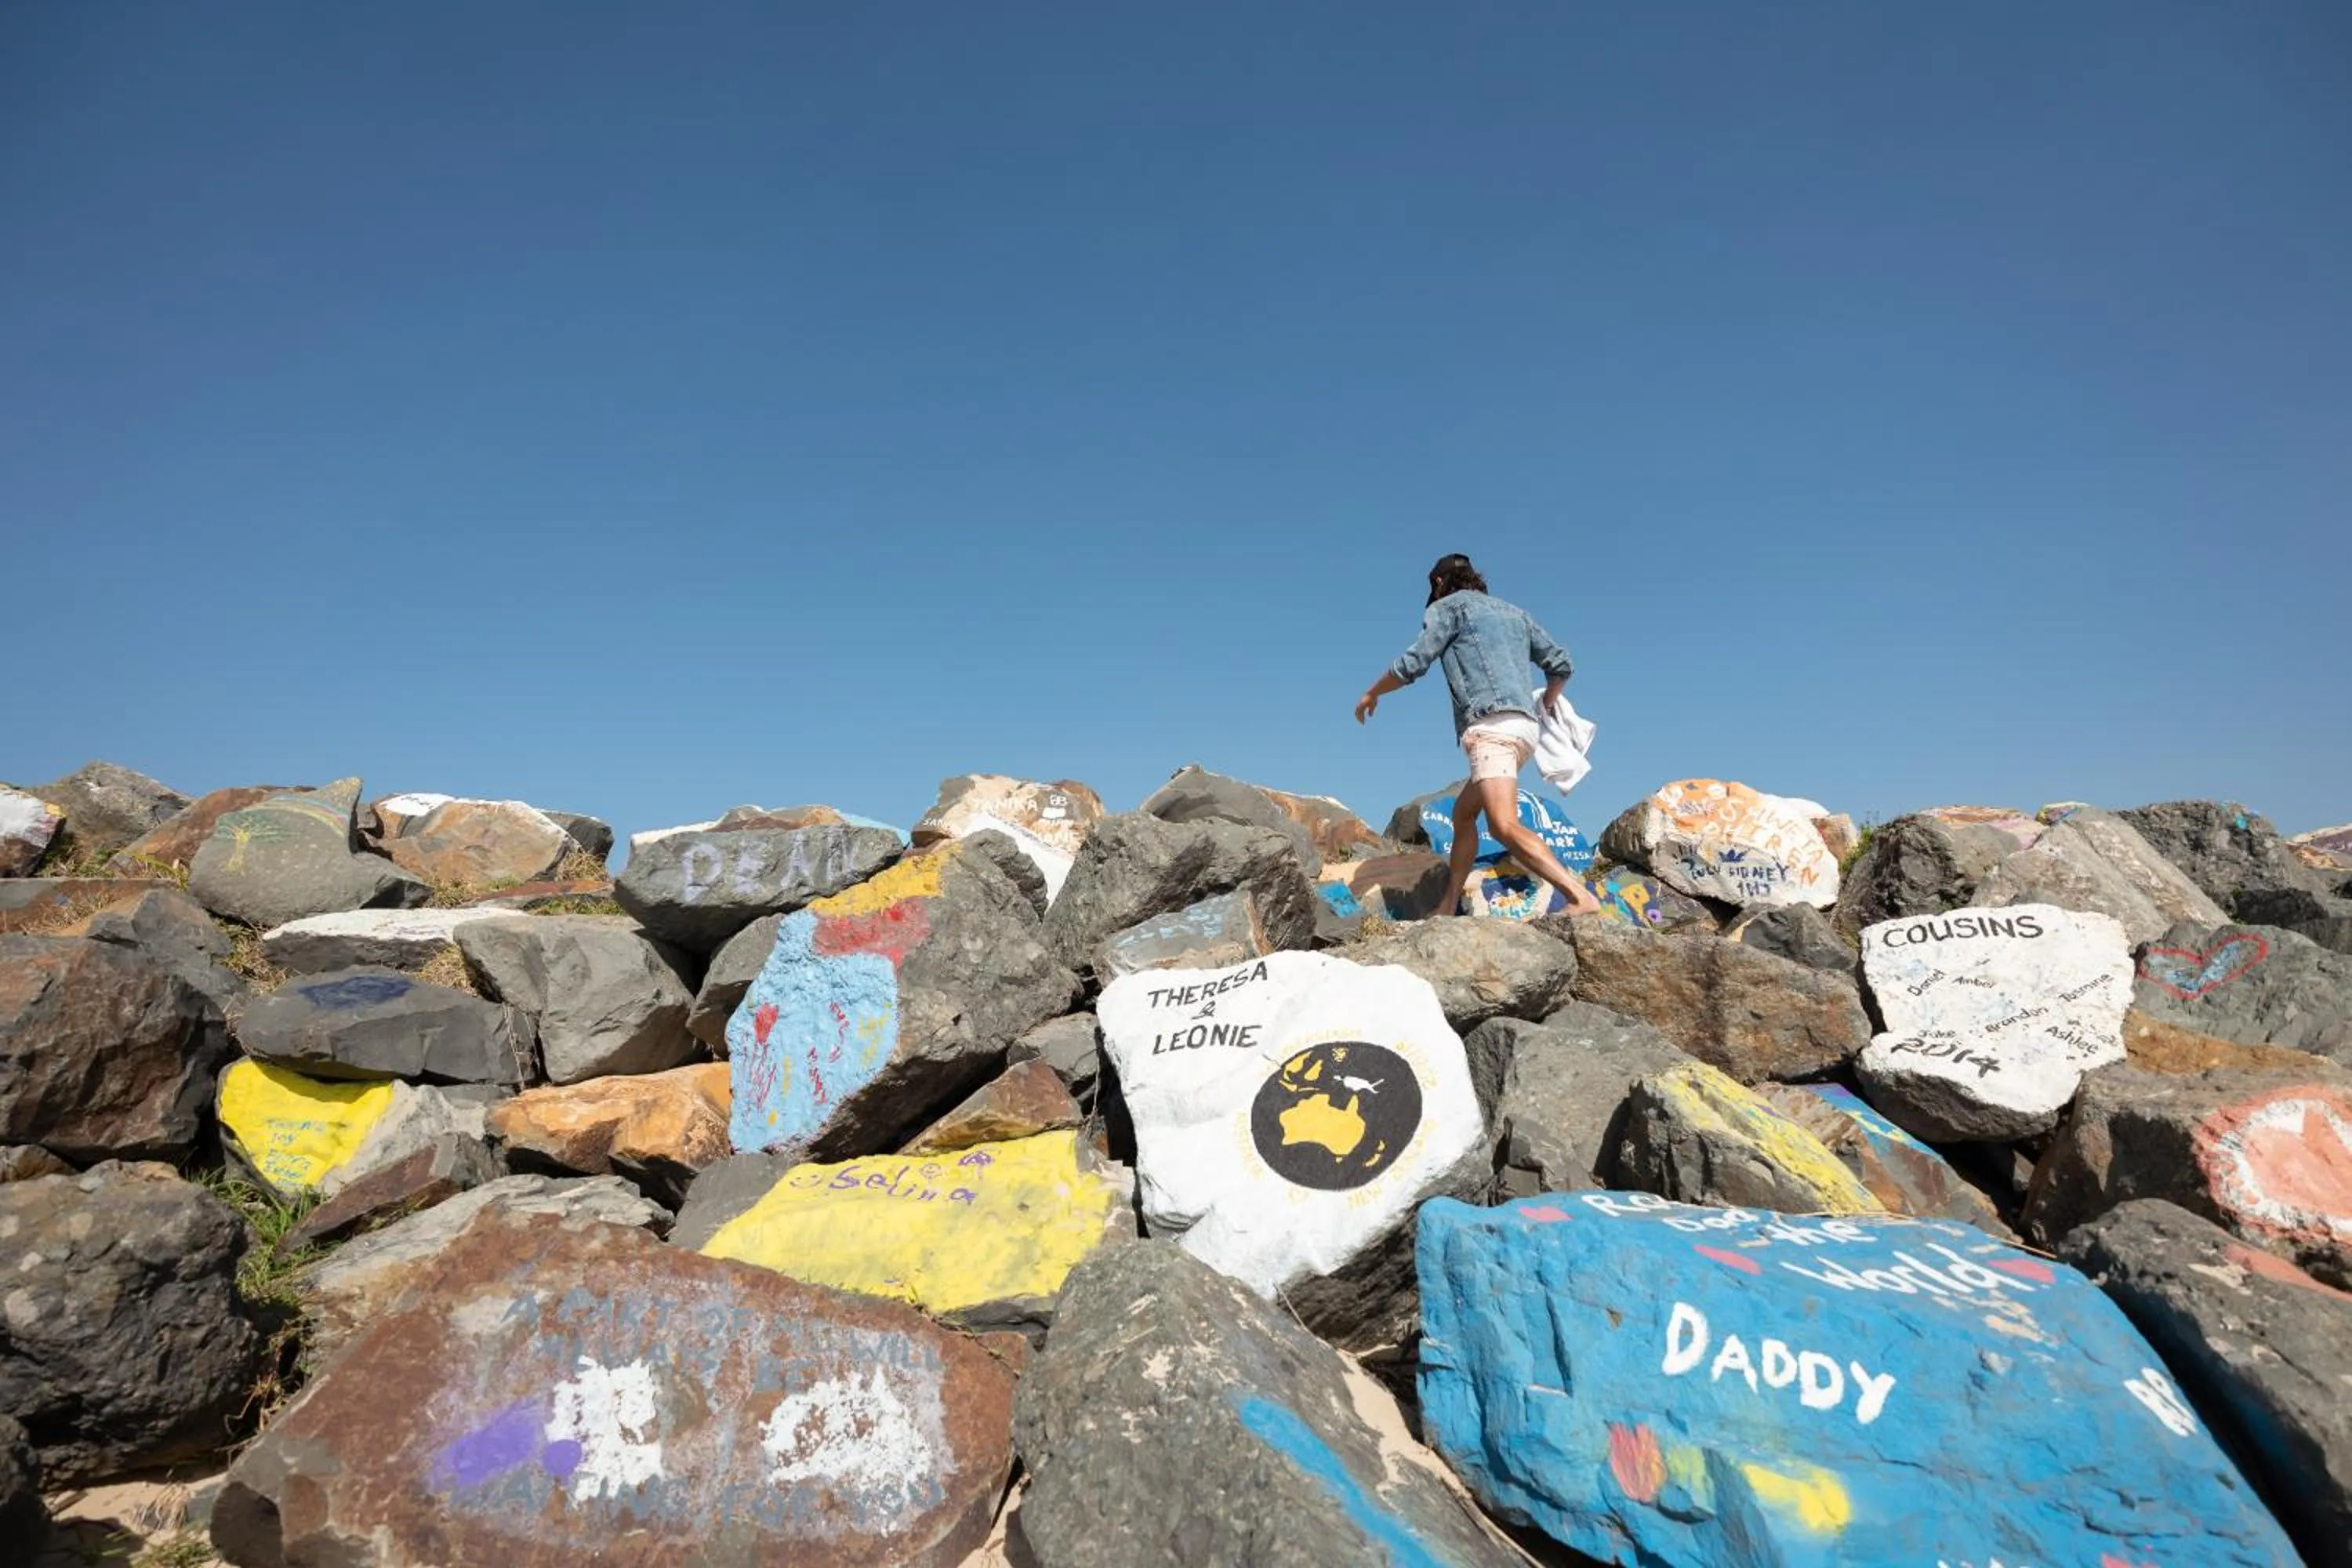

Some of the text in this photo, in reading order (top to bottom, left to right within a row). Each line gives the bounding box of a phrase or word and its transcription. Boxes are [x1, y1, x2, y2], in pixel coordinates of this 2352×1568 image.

[1537, 832, 1575, 848] ARK
[1882, 914, 2045, 948] COUSINS
[1147, 960, 1269, 1009] THERESA
[1190, 1000, 1217, 1020] &
[1984, 1005, 2050, 1033] Brandon
[1152, 1023, 1263, 1056] LEONIE
[2044, 1025, 2100, 1054] Ashlee
[1889, 1036, 2002, 1079] 2014
[827, 1165, 977, 1206] Selina
[1764, 1211, 1878, 1247] the
[1778, 1242, 2037, 1297] World
[1661, 1301, 1897, 1425] DADDY
